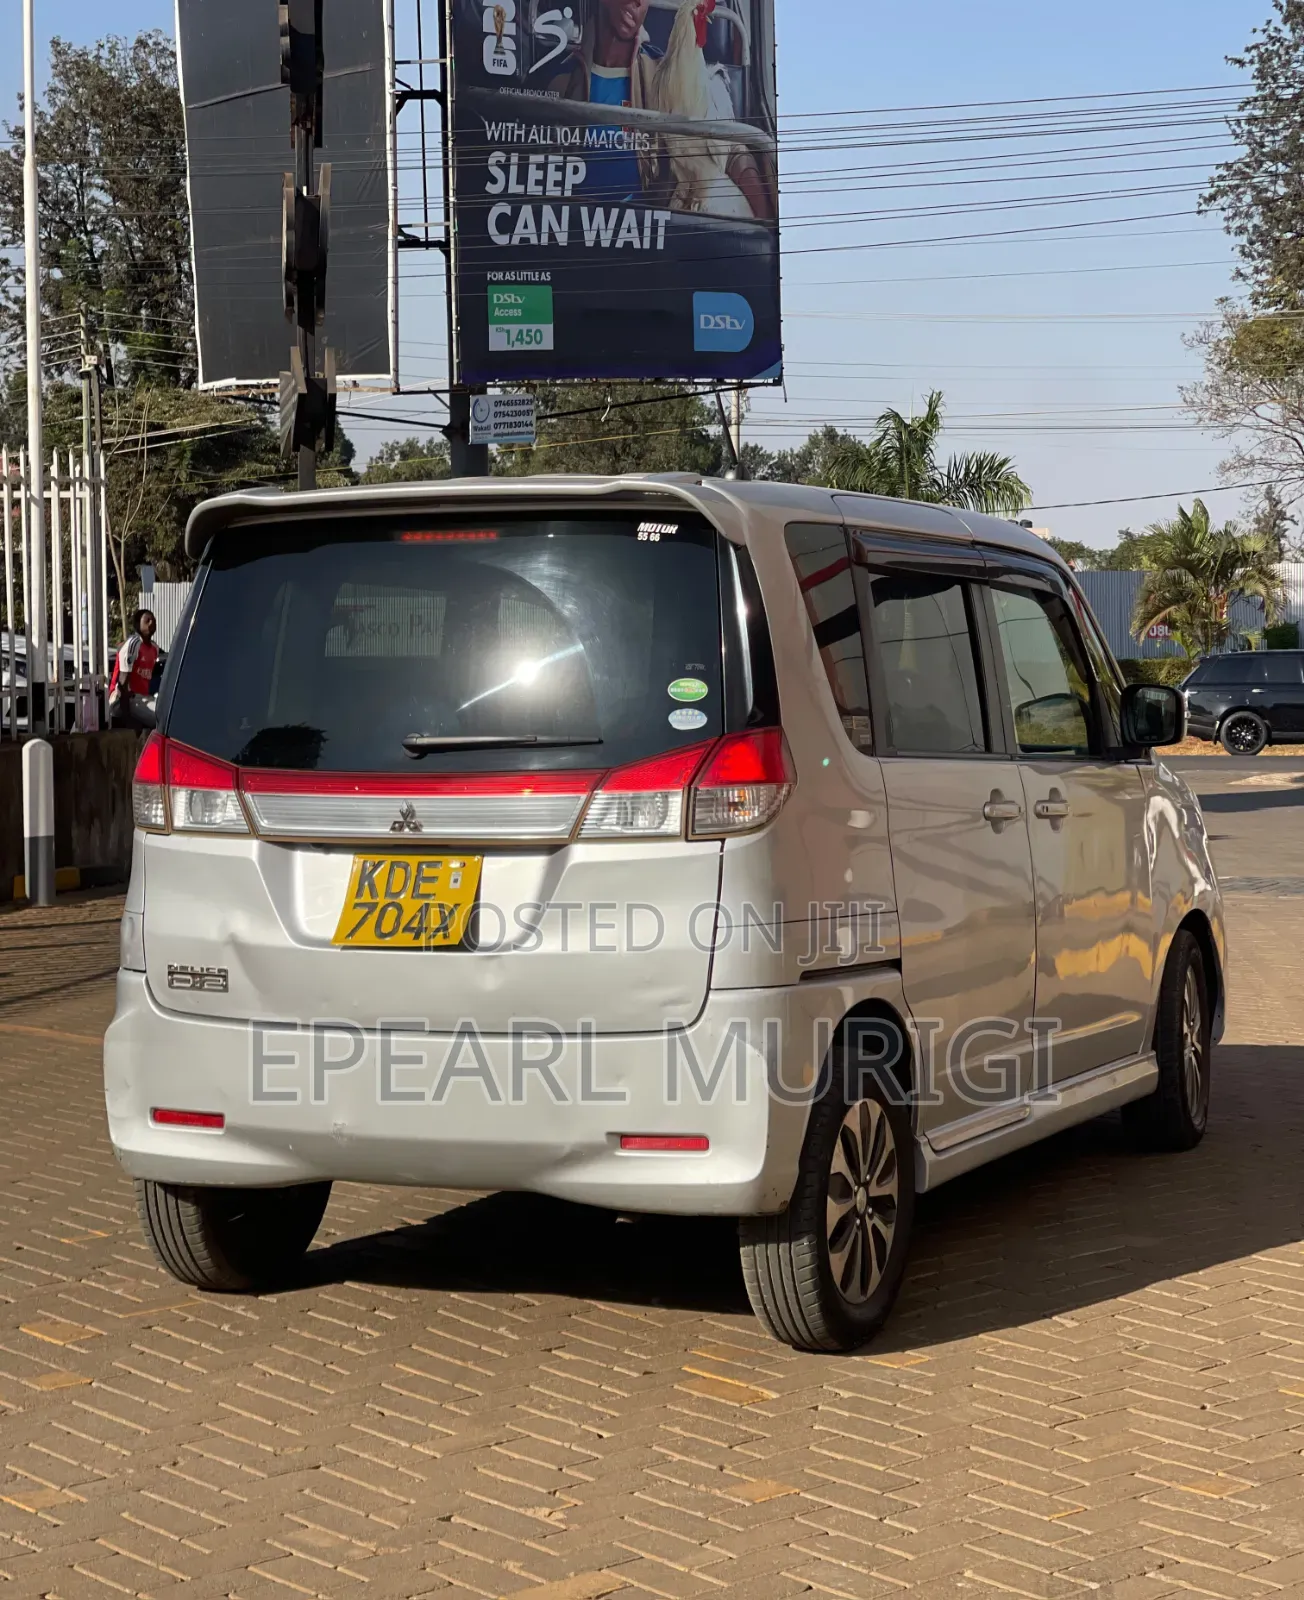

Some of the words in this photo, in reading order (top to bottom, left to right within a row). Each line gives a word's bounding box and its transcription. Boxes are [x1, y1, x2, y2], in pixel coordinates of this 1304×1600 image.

[492, 58, 508, 68] FIFA
[499, 86, 521, 97] OFFICIAL
[485, 120, 526, 143] WITH
[527, 124, 553, 145] ALL
[556, 126, 580, 146] 104
[583, 128, 650, 152] MATCHES
[485, 150, 587, 197] SLEEP
[487, 202, 570, 246] CAN
[580, 206, 671, 250] WAIT
[487, 271, 504, 281] FOR
[505, 271, 516, 281] AS
[517, 271, 539, 281] LITTLE
[540, 271, 551, 281] AS
[494, 307, 522, 317] Access
[505, 328, 543, 348] 1,450
[637, 532, 648, 541] 55
[649, 533, 660, 542] 66
[355, 860, 443, 900] KDE
[345, 901, 461, 941] 704X
